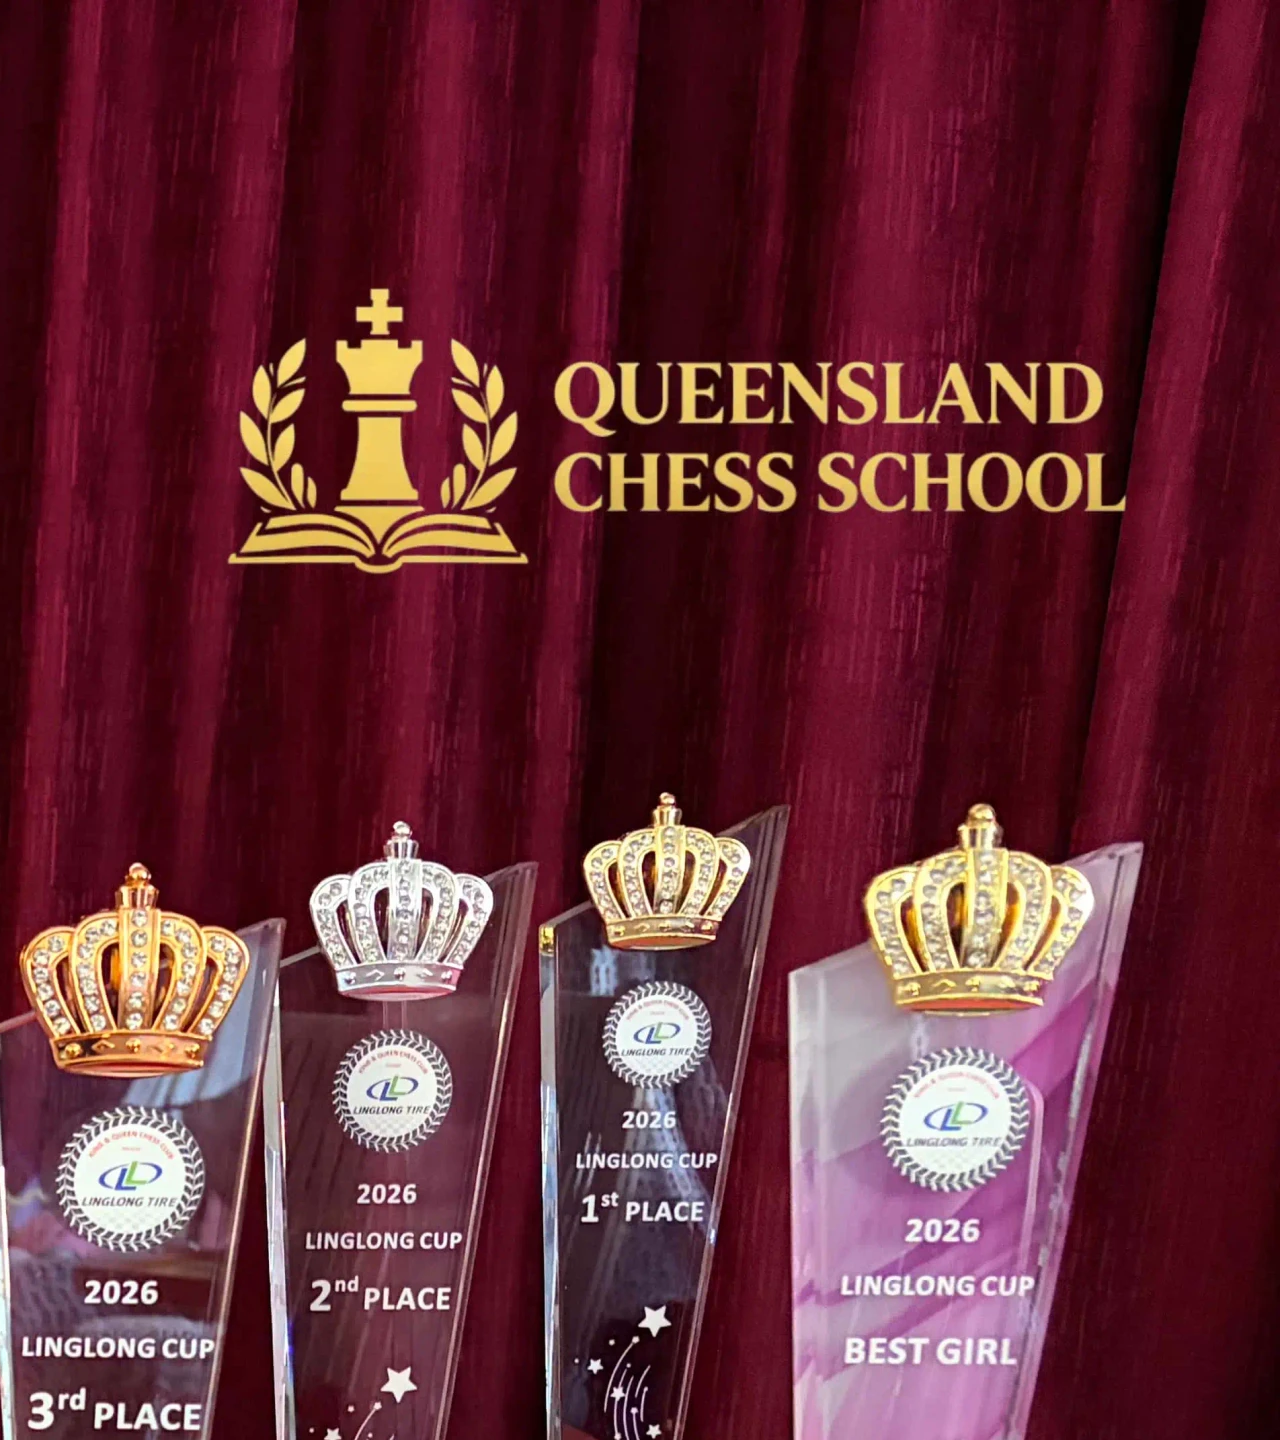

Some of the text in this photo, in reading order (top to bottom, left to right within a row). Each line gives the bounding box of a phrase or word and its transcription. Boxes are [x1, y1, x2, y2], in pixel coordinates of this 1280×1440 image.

[622, 1111, 676, 1129] 2026
[576, 1153, 718, 1169] LINGLONG CUP
[357, 1184, 417, 1204] 2026
[581, 1192, 705, 1223] 1st PLACE
[306, 1232, 463, 1250] LINGLONG CUP
[905, 1219, 980, 1242] 2026
[84, 1280, 158, 1304] 2026
[310, 1276, 451, 1311] 2nd PLACE
[841, 1275, 1035, 1297] LINGLONG CUP
[21, 1336, 215, 1359] LINGLONG CUP
[844, 1338, 1017, 1365] BEST GIRL
[27, 1388, 201, 1430] 3rd PLACE
